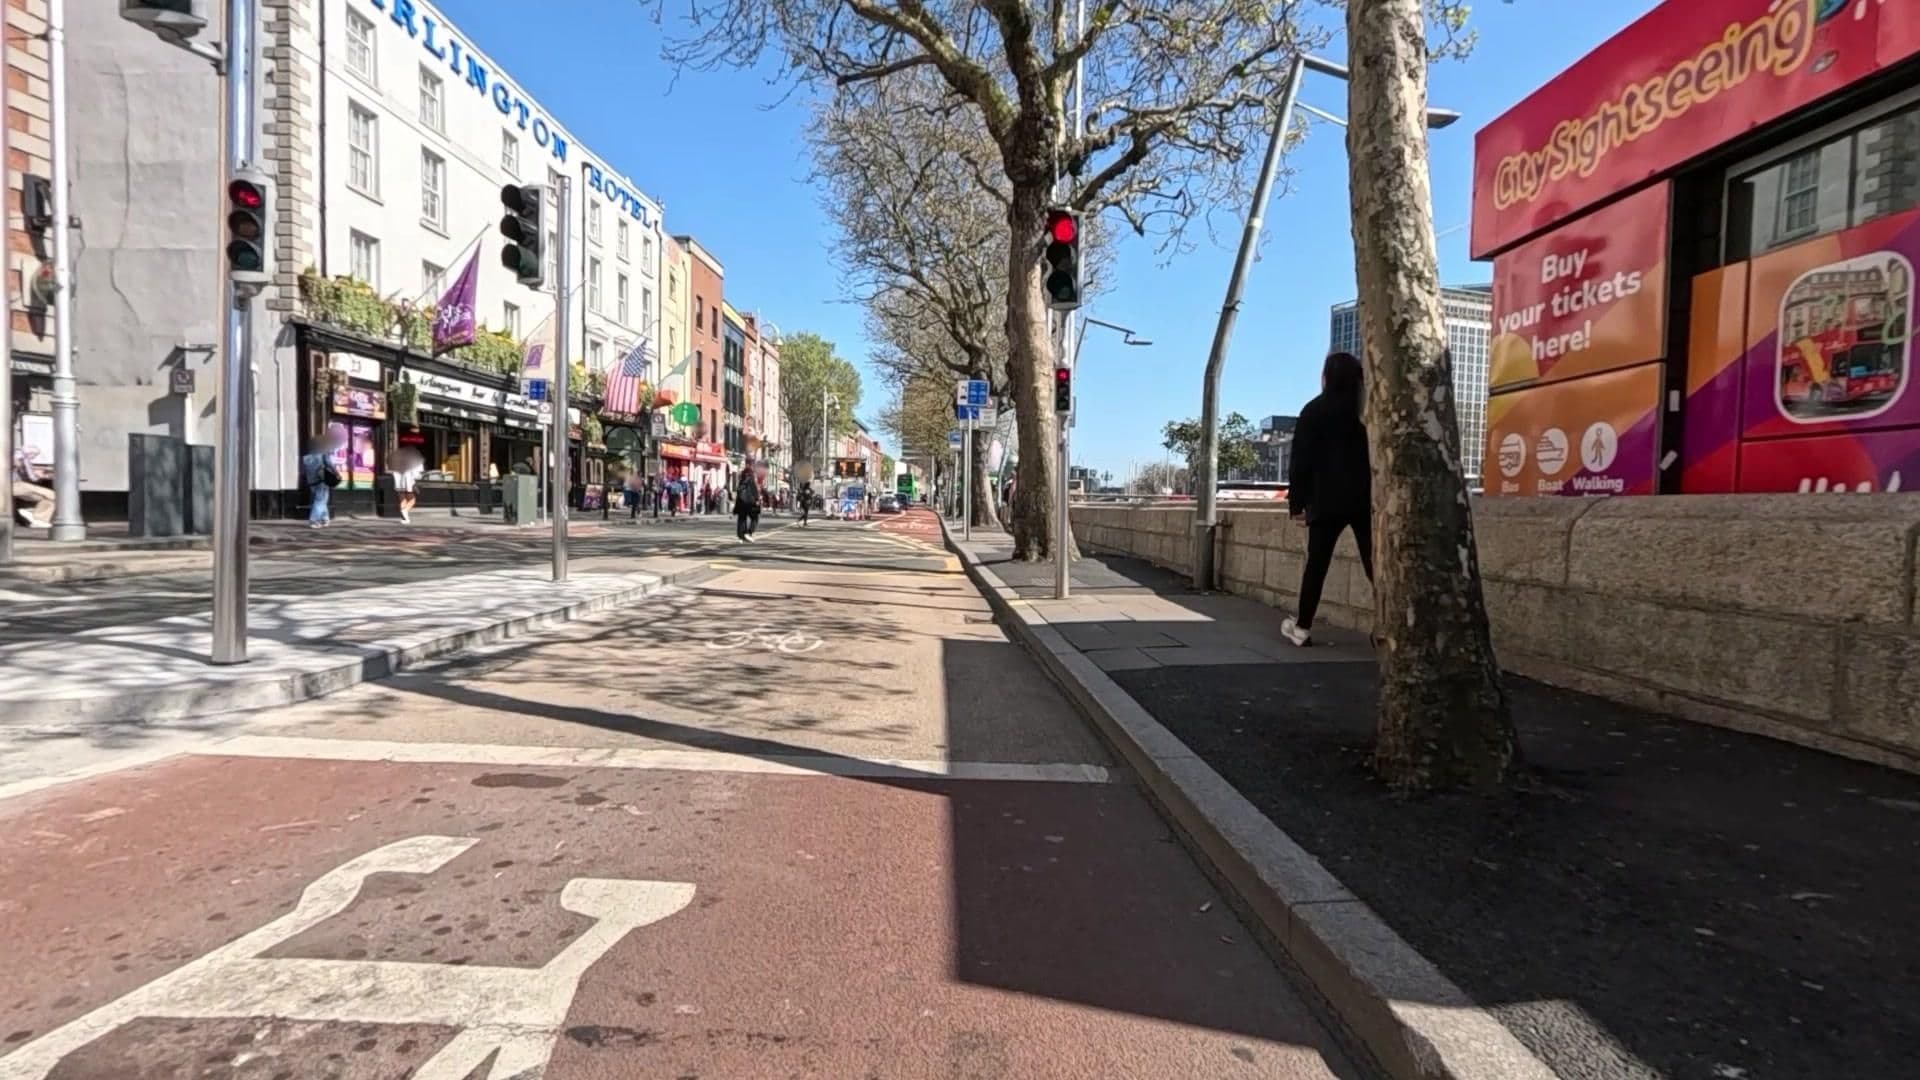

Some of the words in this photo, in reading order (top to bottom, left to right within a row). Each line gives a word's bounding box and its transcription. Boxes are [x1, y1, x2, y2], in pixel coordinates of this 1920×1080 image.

[370, 0, 568, 163] RLINGTON
[587, 163, 652, 229] HOTEL
[1541, 248, 1588, 284] Buy
[1499, 303, 1545, 339] your
[1551, 270, 1641, 317] tickets
[1531, 320, 1592, 361] here!
[1537, 479, 1564, 491] Boat
[1572, 475, 1624, 492] Walking
